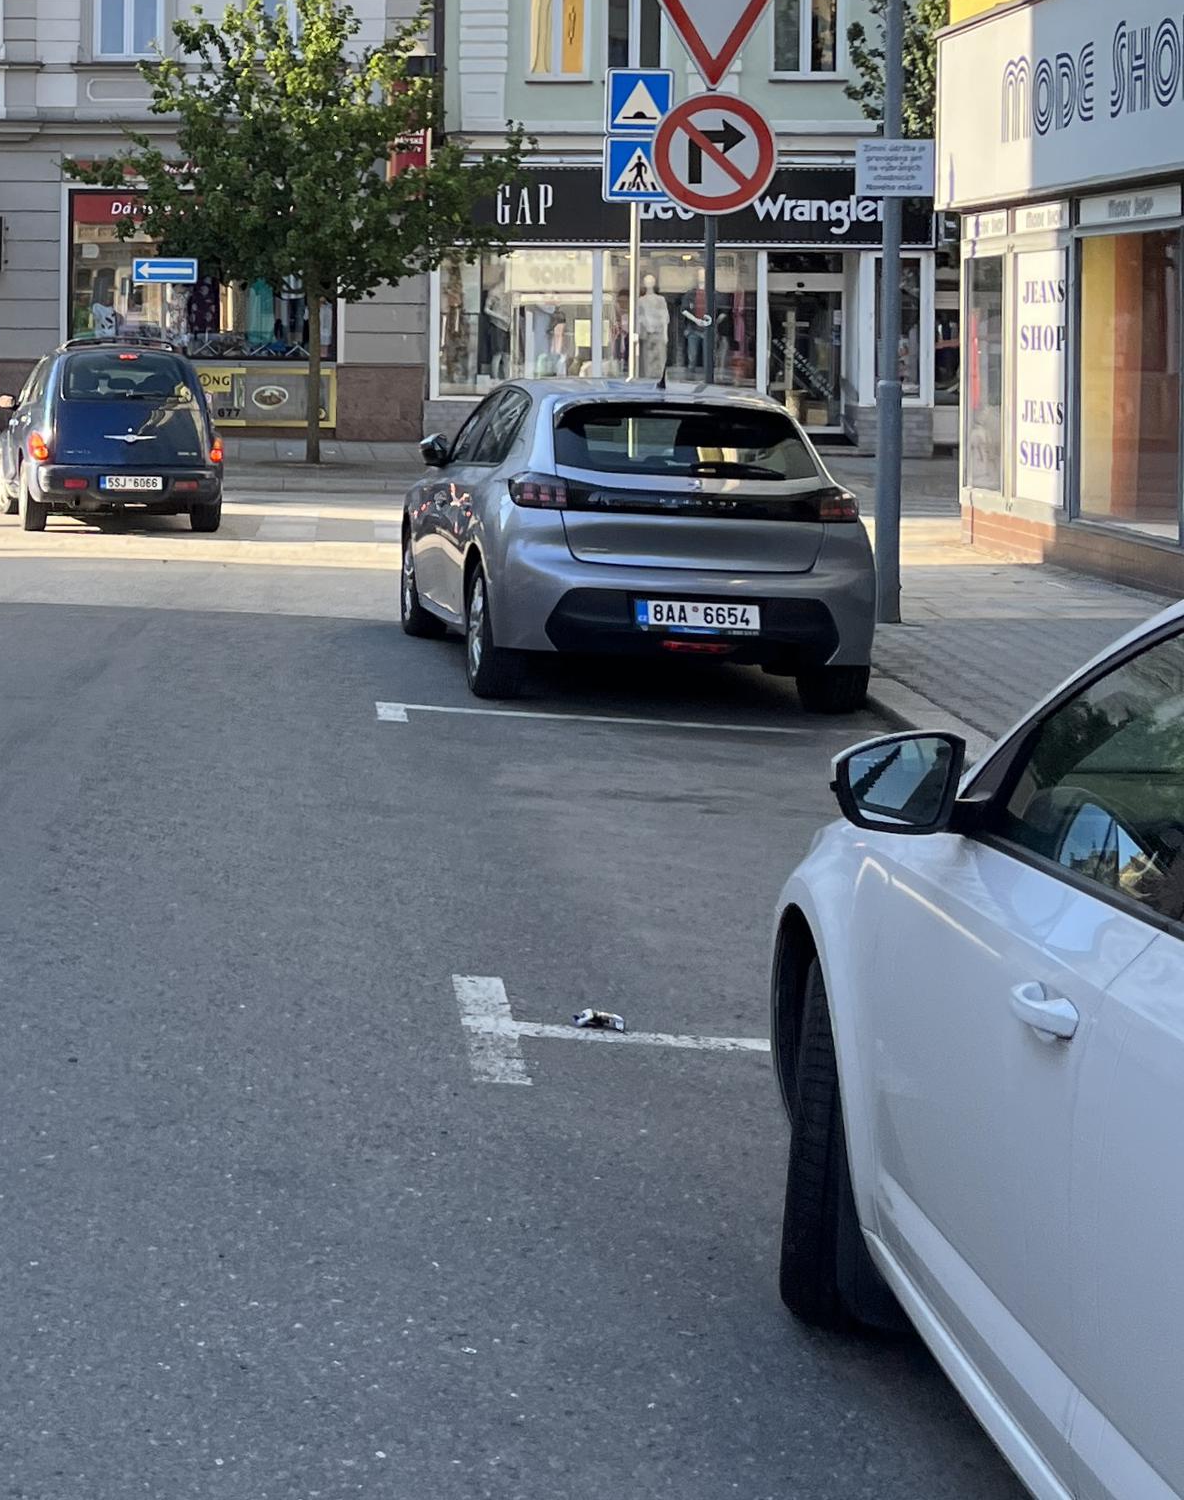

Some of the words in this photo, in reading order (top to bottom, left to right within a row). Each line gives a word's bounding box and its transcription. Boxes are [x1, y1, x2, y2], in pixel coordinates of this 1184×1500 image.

[1001, 41, 1094, 144] MODE
[1110, 13, 1184, 118] SHO
[496, 184, 553, 226] GAP
[1022, 279, 1065, 304] JEANS
[1020, 325, 1065, 351] SHOP
[1022, 400, 1063, 425] JEANS
[1020, 440, 1064, 471] SHOP
[108, 477, 127, 488] 5SJ
[653, 603, 688, 623] 8AA
[703, 605, 750, 626] 6654
